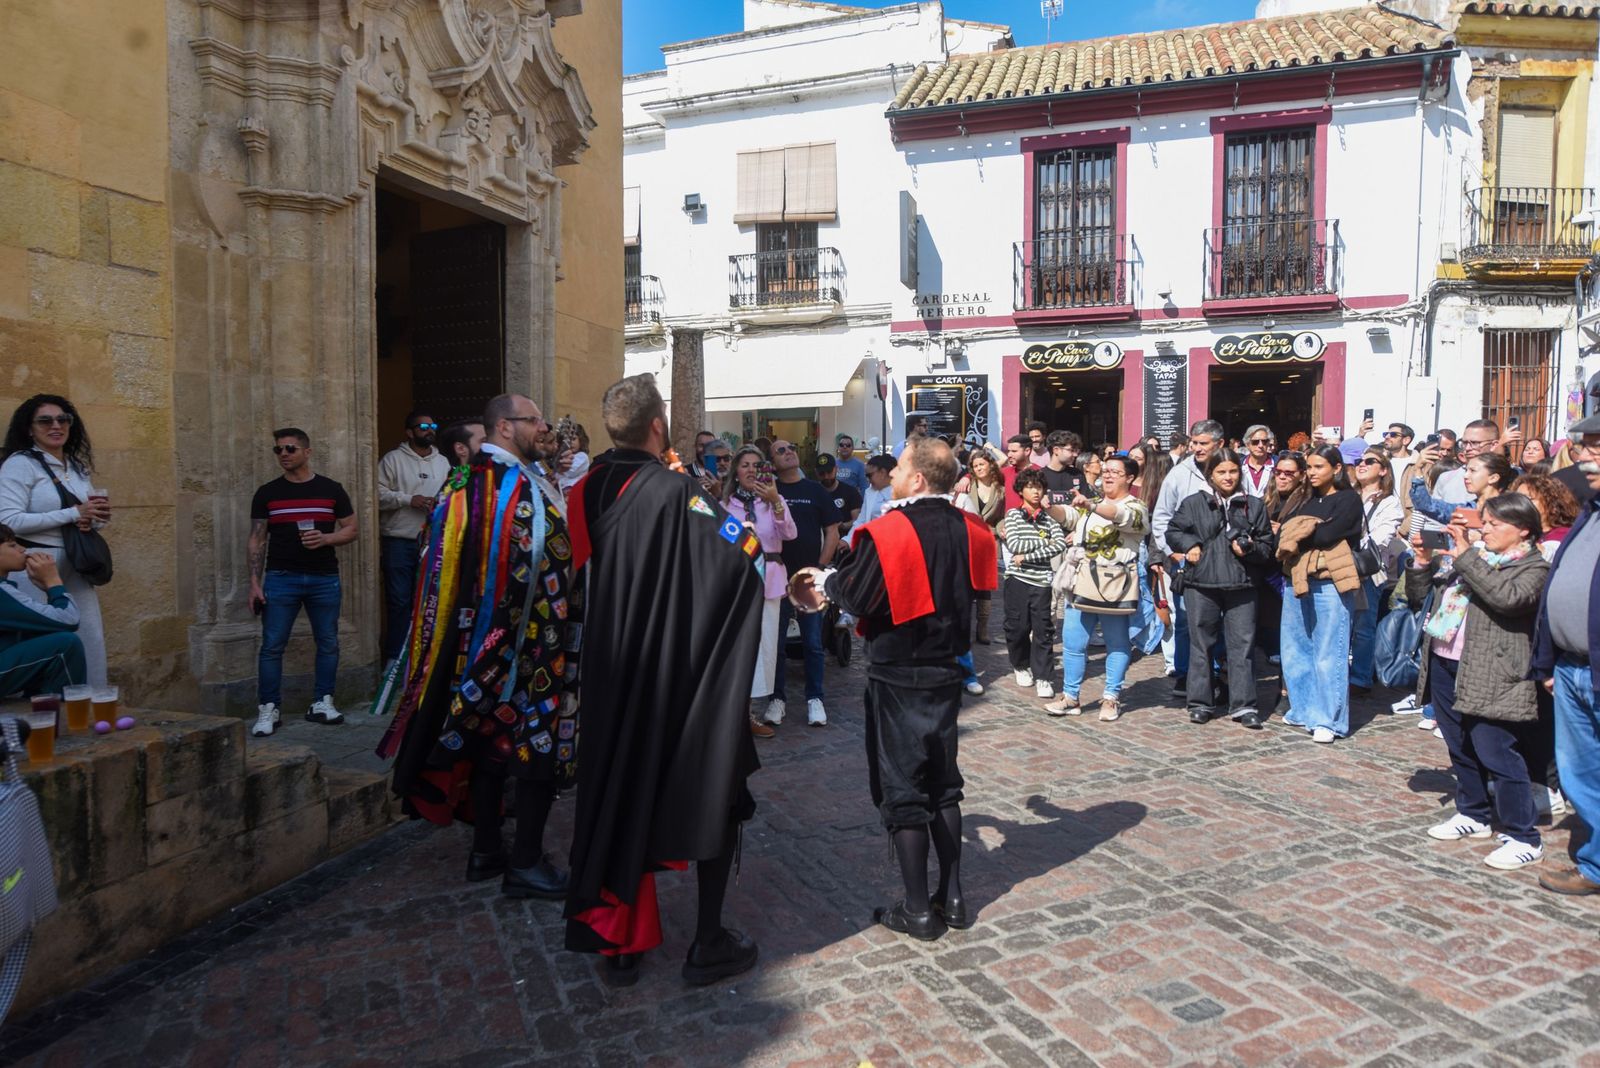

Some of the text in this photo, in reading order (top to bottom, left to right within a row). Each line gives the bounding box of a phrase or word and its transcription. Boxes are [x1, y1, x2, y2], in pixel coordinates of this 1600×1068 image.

[912, 292, 990, 305] CARDENAL
[916, 305, 985, 318] HERRERO
[1260, 335, 1288, 346] Casa
[1064, 344, 1090, 355] Casa
[1219, 342, 1236, 356] El
[1027, 351, 1044, 365] El
[935, 376, 963, 384] CARTA
